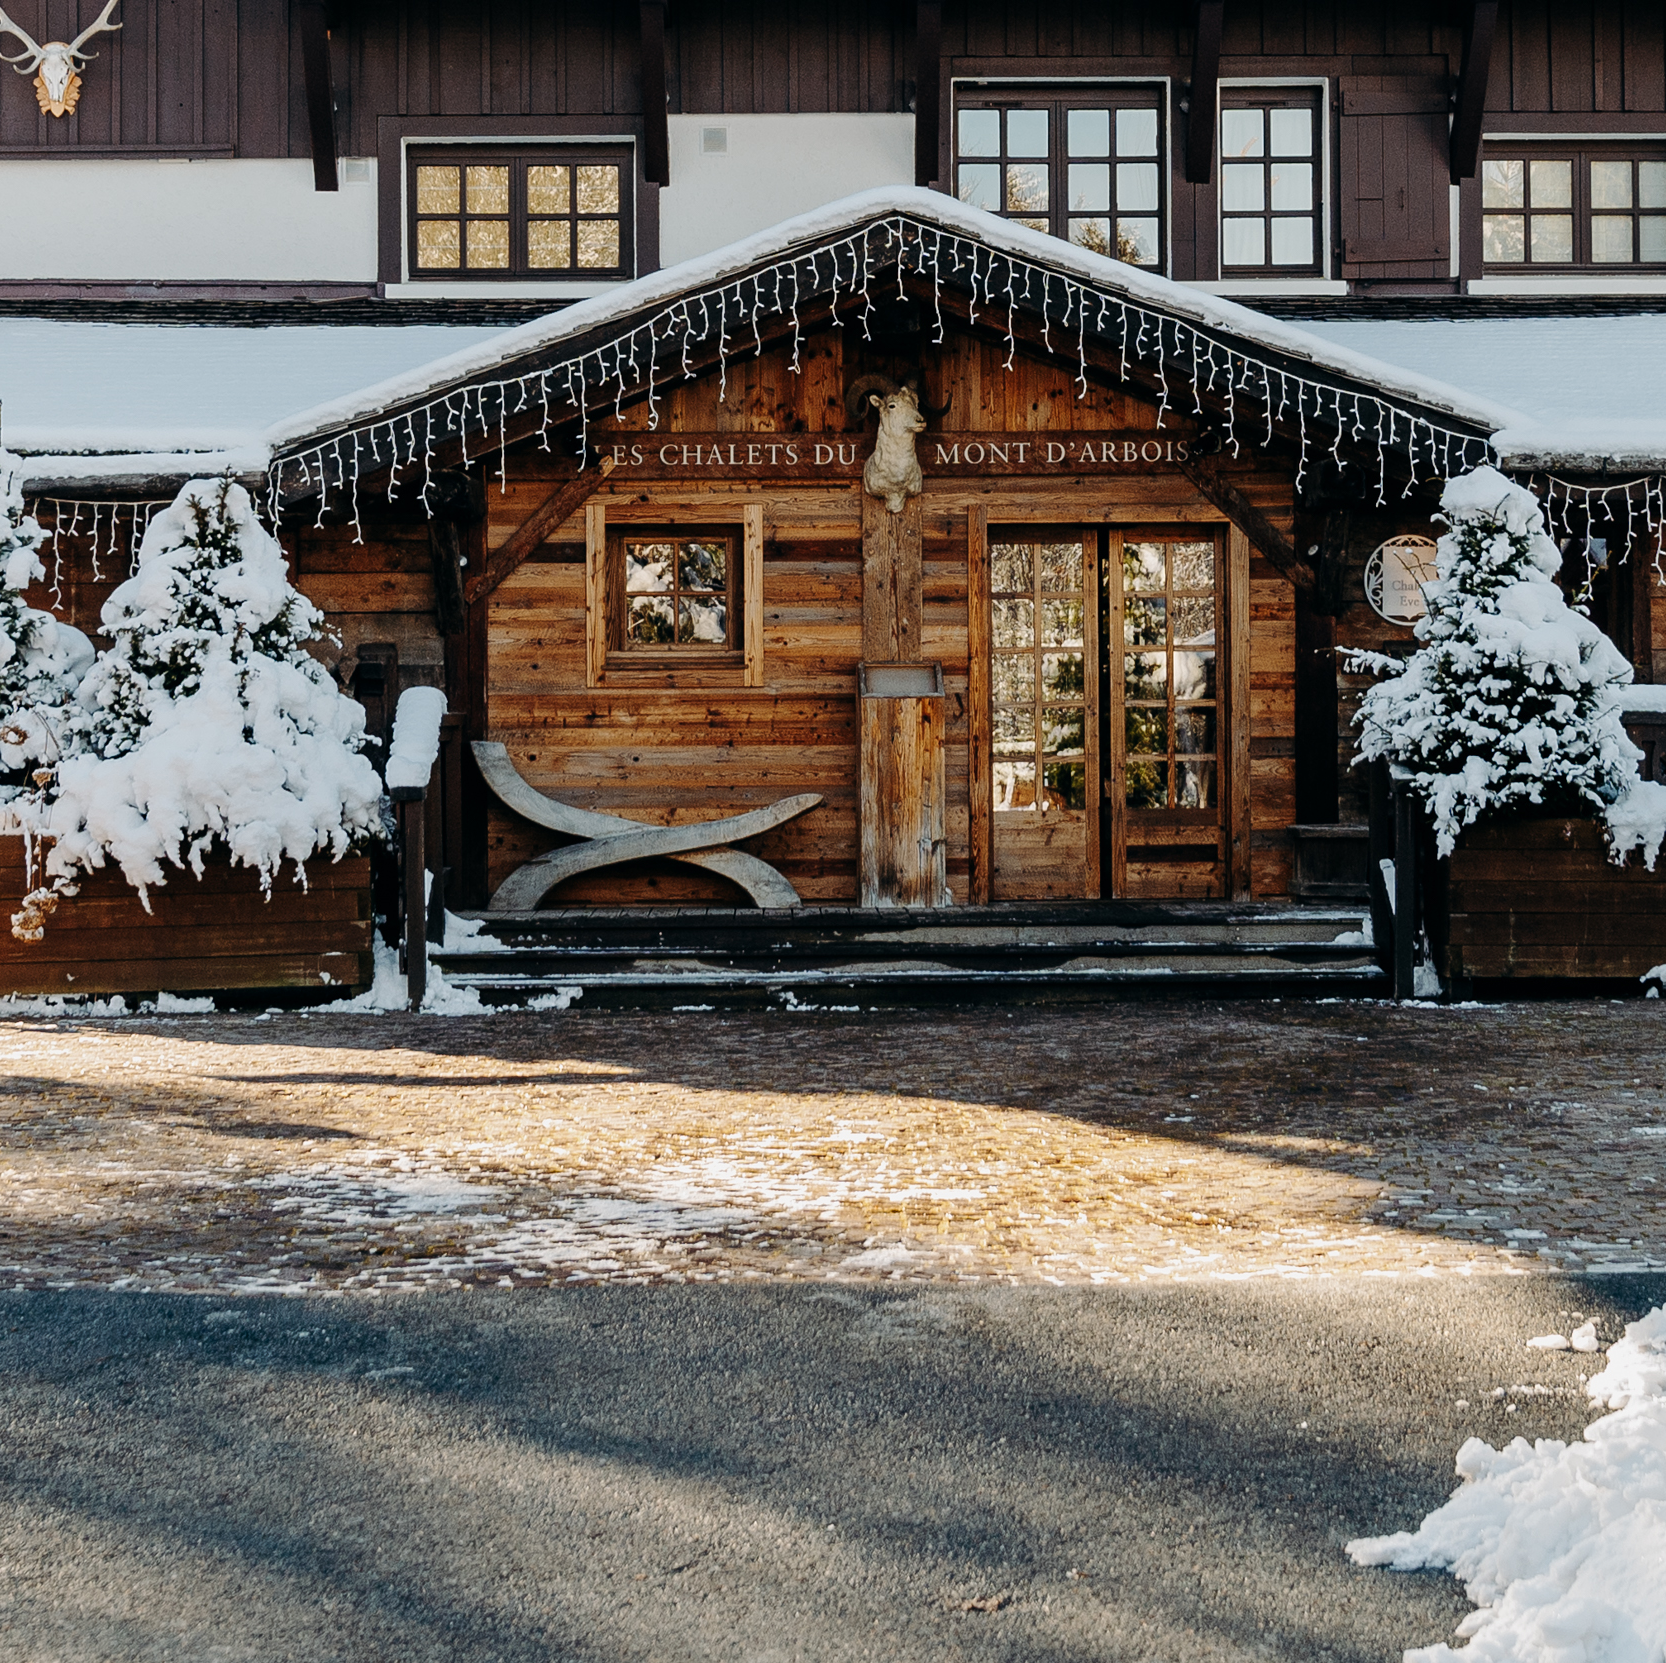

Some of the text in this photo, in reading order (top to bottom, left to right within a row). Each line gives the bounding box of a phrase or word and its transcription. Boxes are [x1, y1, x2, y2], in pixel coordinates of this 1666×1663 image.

[659, 443, 799, 466] CHALETS
[813, 443, 857, 465] DU
[934, 441, 1031, 465] MONT
[1046, 439, 1190, 464] D'ARBOIS
[1392, 580, 1419, 591] Chal
